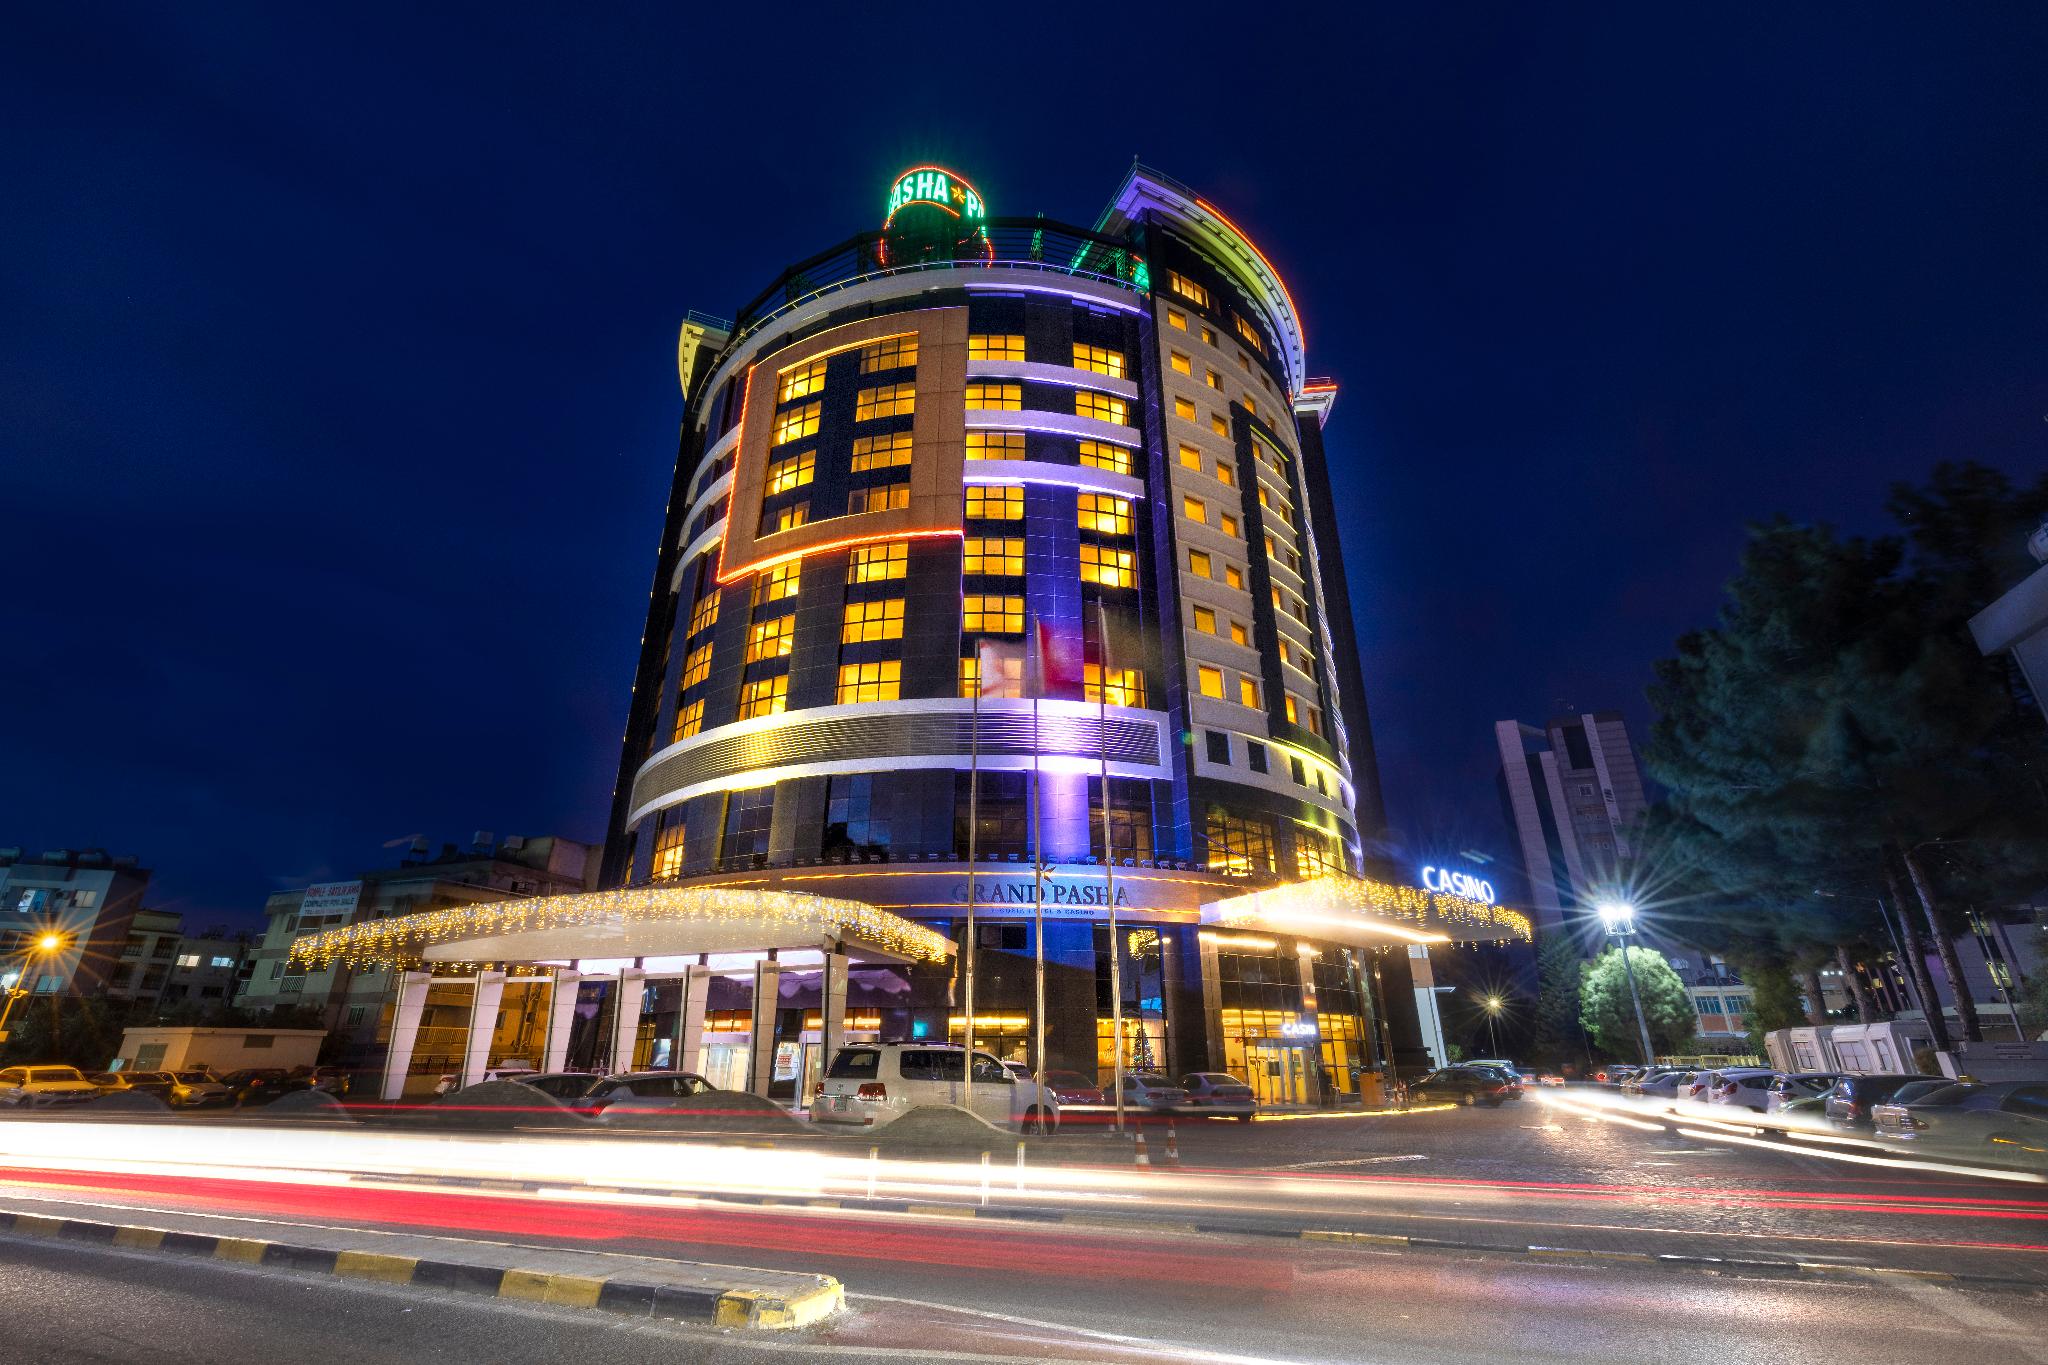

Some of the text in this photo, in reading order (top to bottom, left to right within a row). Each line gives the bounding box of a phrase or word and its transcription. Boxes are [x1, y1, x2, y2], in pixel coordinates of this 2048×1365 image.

[952, 882, 1131, 907] GRAND PASHA
[1422, 865, 1495, 905] CASINO
[1065, 908, 1095, 917] CASINO
